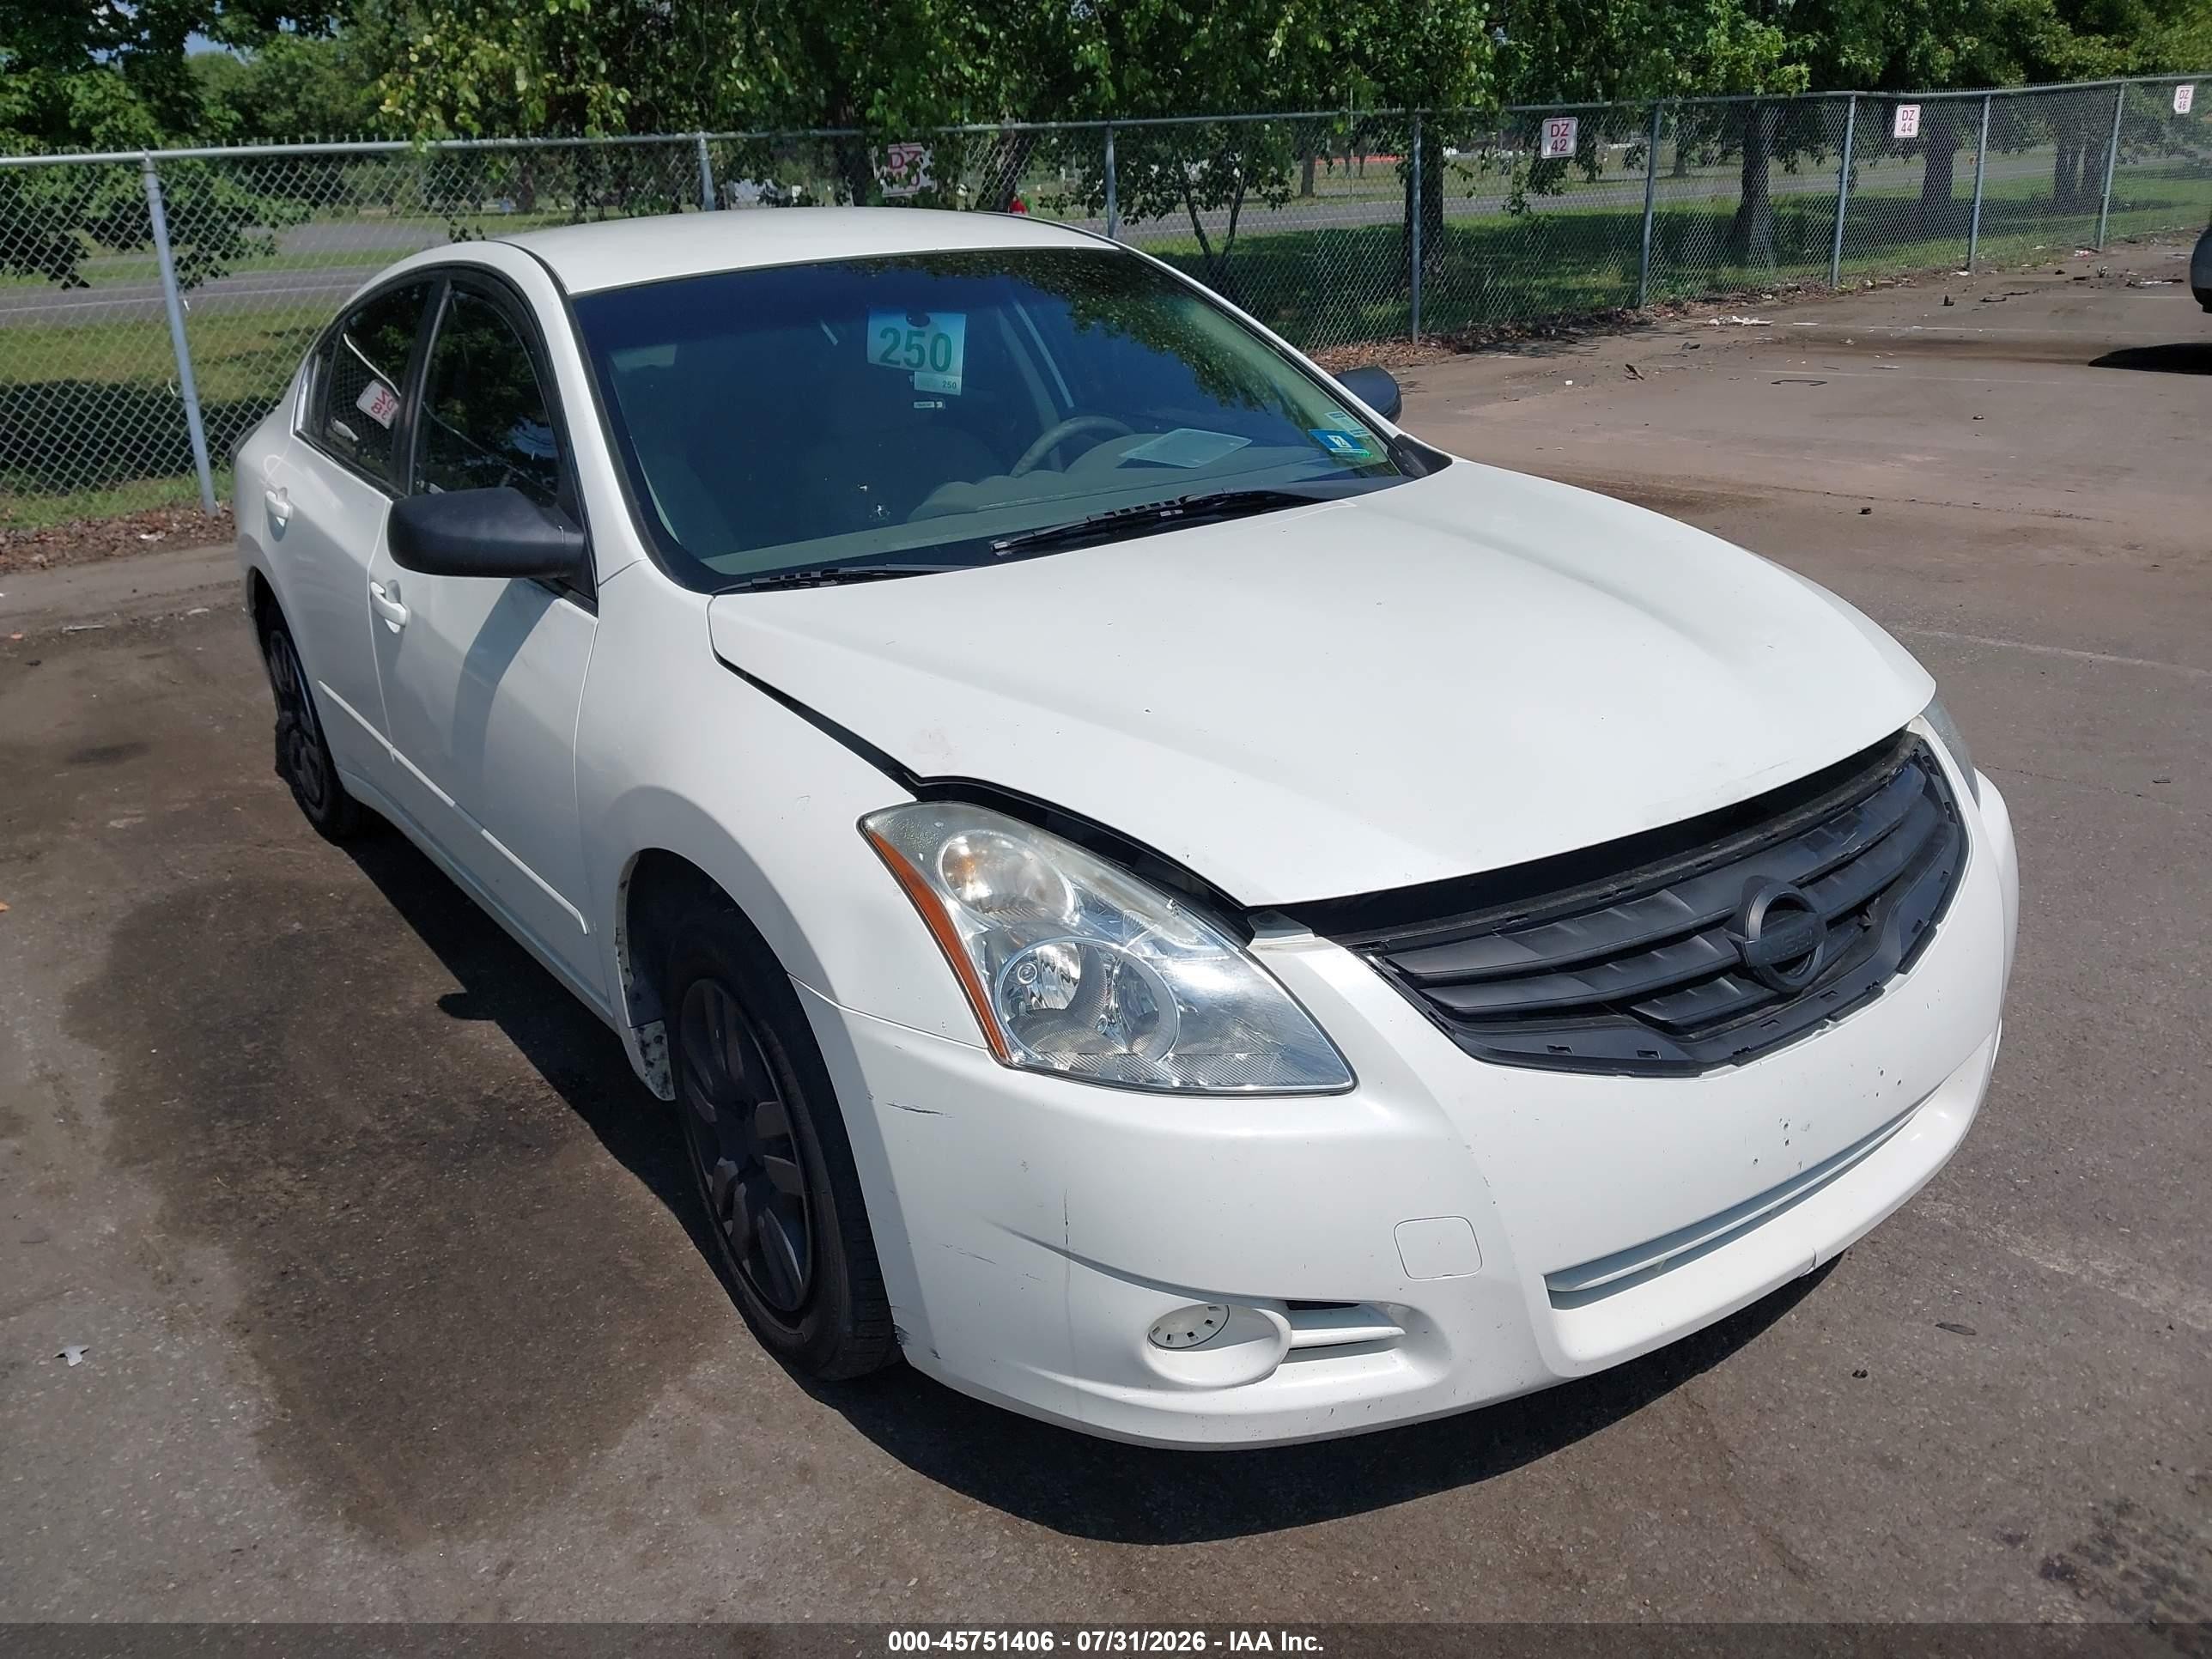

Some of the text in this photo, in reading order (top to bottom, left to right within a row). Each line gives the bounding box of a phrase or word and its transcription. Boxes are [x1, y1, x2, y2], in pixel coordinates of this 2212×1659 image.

[2179, 89, 2190, 100] DZ
[1901, 109, 1915, 121] DZ
[1551, 123, 1569, 137] DZ
[1900, 122, 1912, 133] 44
[1551, 138, 1567, 152] 42
[878, 326, 952, 372] 250
[942, 379, 957, 390] 250
